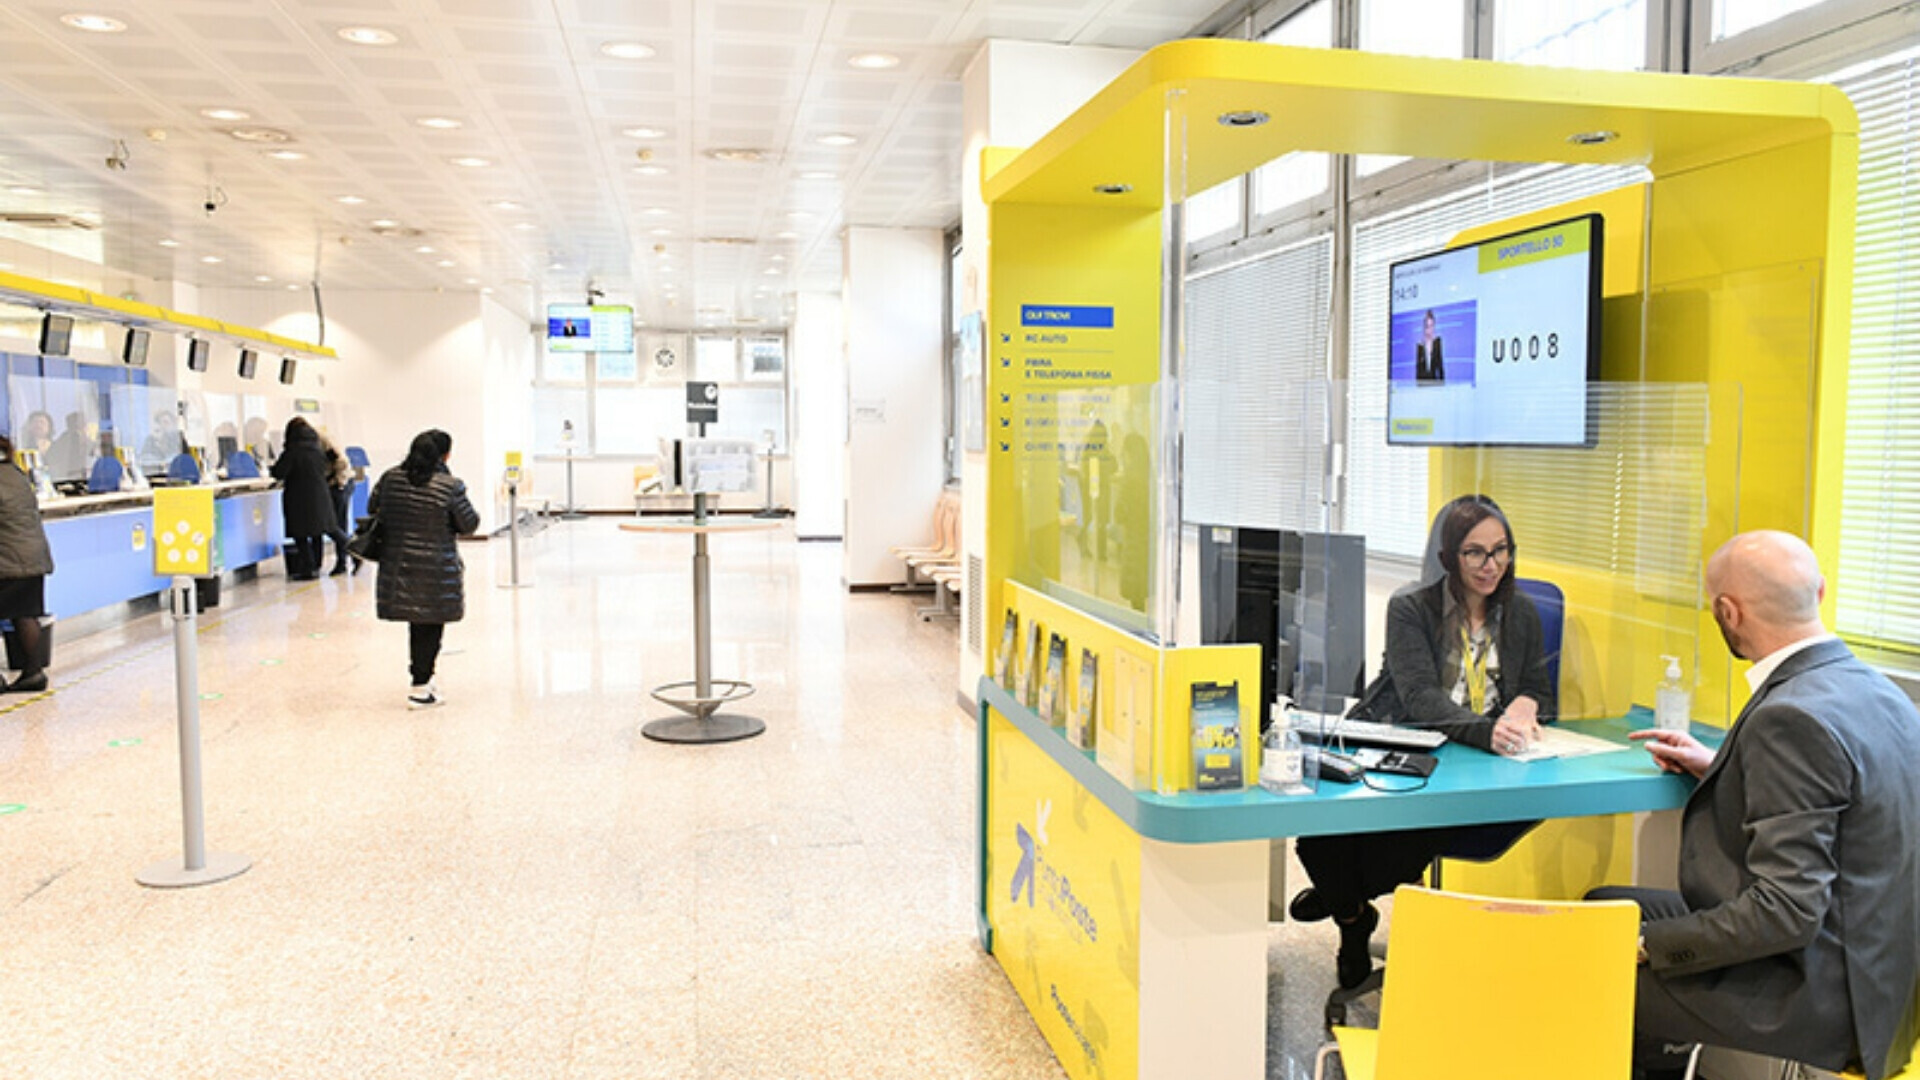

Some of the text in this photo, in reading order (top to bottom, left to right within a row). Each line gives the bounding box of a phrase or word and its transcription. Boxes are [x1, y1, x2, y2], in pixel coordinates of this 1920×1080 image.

[1497, 237, 1550, 262] SPORTELLO
[1025, 311, 1071, 320] QUI TROVI
[1025, 334, 1068, 343] RC AUTO
[1492, 332, 1559, 363] U008
[1025, 358, 1052, 367] FIBRA
[1034, 370, 1083, 379] TELEFONIA
[1085, 371, 1111, 379] FISSA
